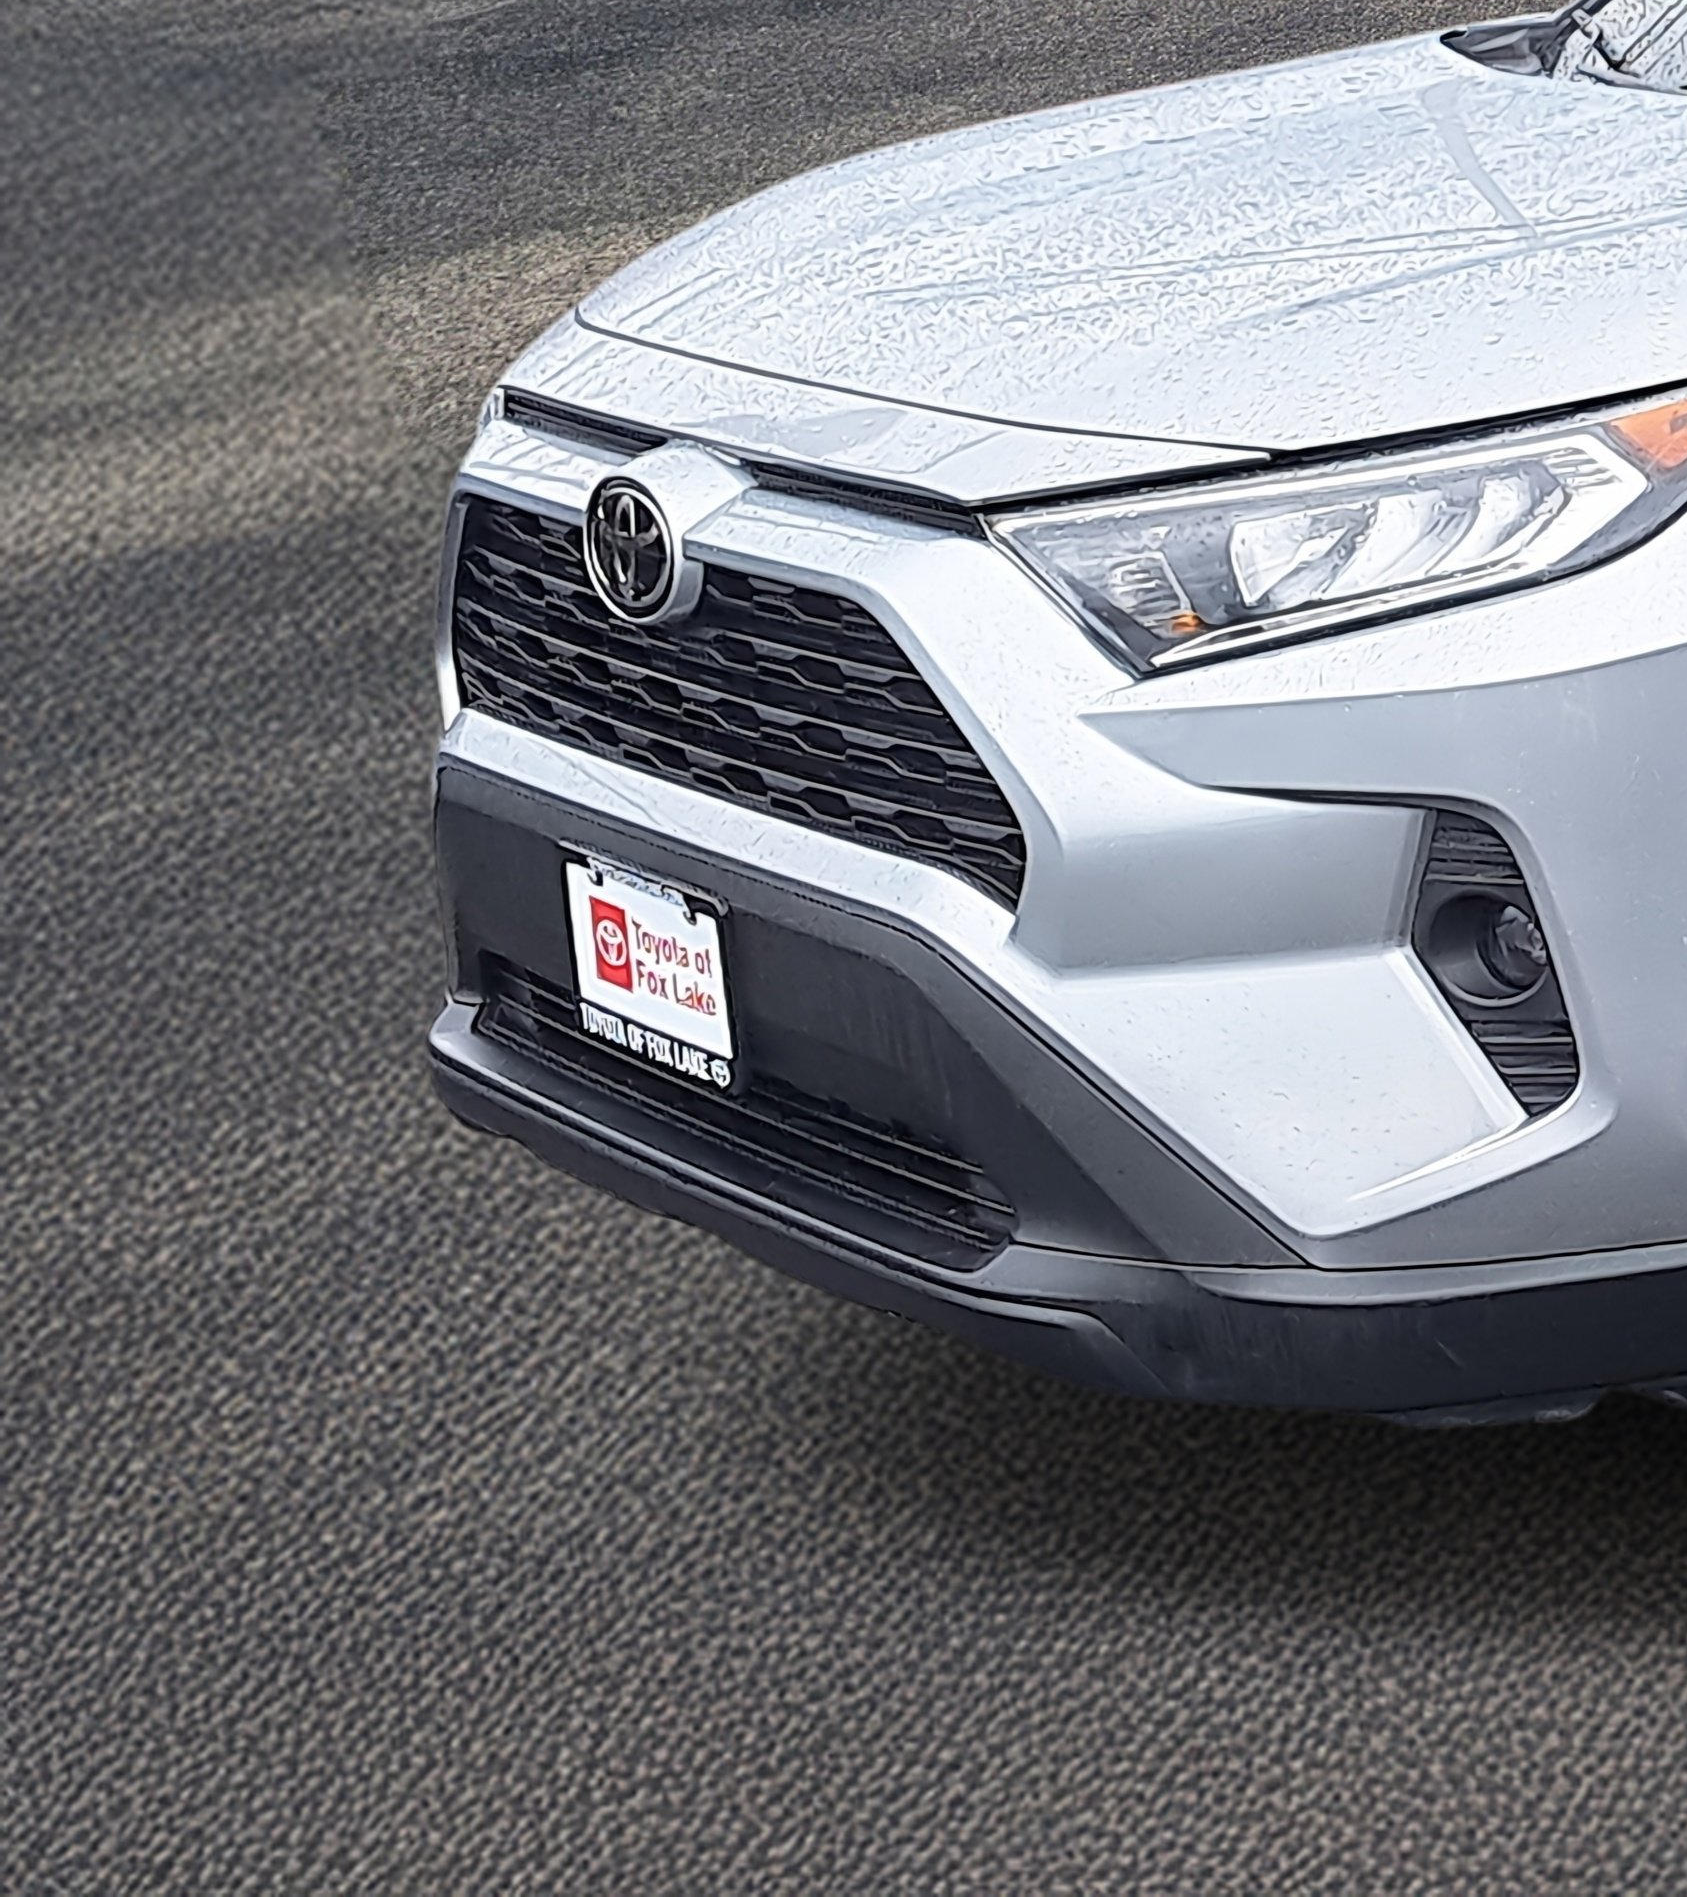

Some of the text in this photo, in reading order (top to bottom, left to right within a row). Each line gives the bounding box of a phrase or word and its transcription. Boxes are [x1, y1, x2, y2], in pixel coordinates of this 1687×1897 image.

[630, 914, 714, 979] Toyota of
[635, 957, 717, 1017] Fox Lake
[645, 1030, 674, 1068] FOX
[673, 1041, 713, 1082] LAKE
